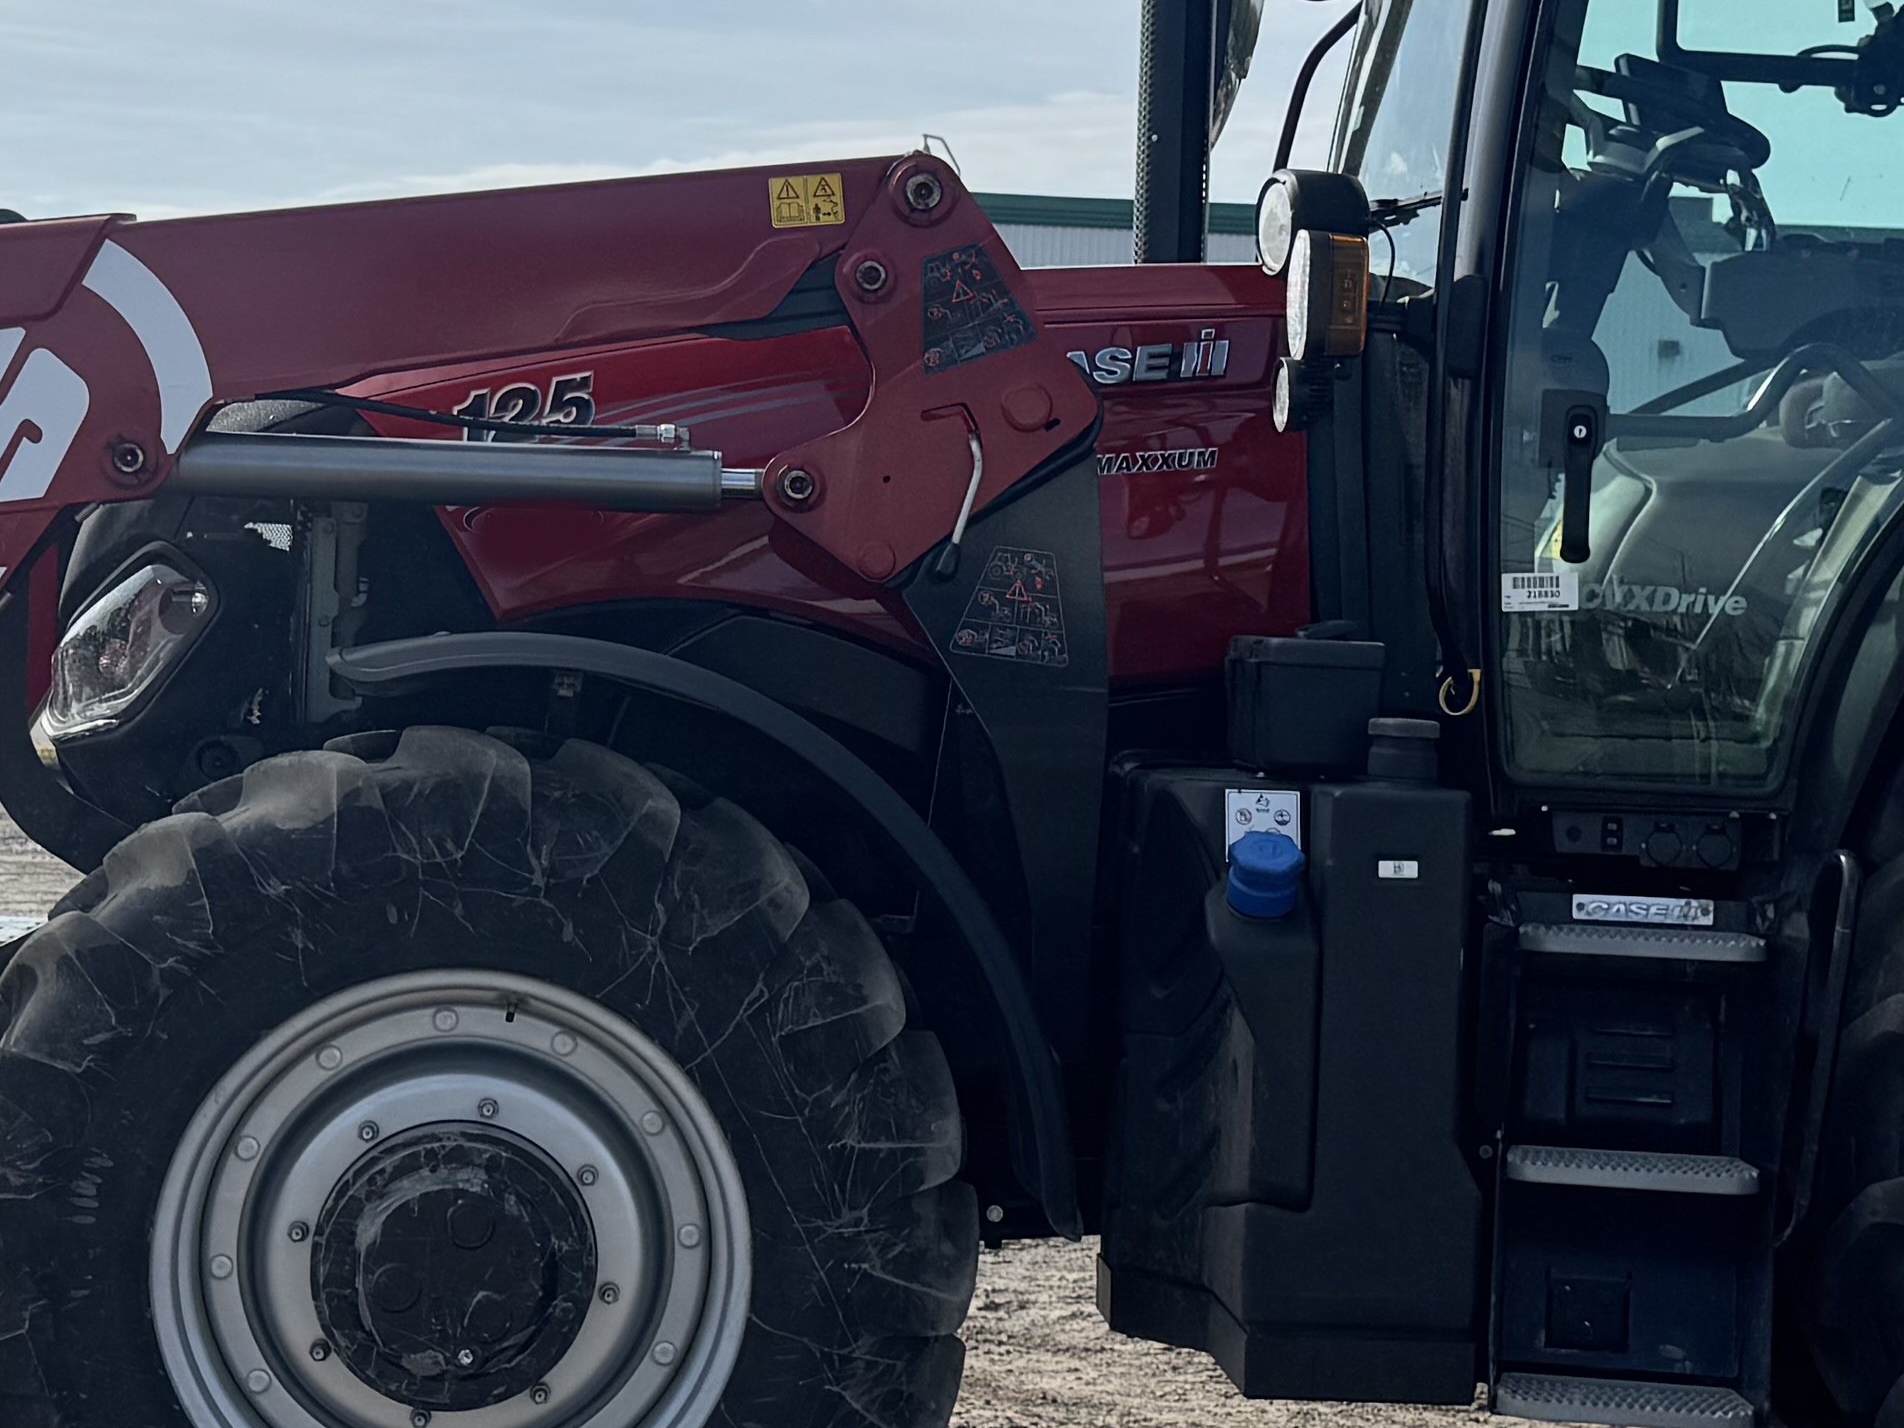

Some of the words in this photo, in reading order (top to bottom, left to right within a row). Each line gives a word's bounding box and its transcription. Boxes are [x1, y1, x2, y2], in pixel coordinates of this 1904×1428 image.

[1066, 343, 1173, 385] SE
[452, 370, 596, 443] 125
[1096, 447, 1219, 476] MAXXUM
[1586, 900, 1670, 921] CASE
